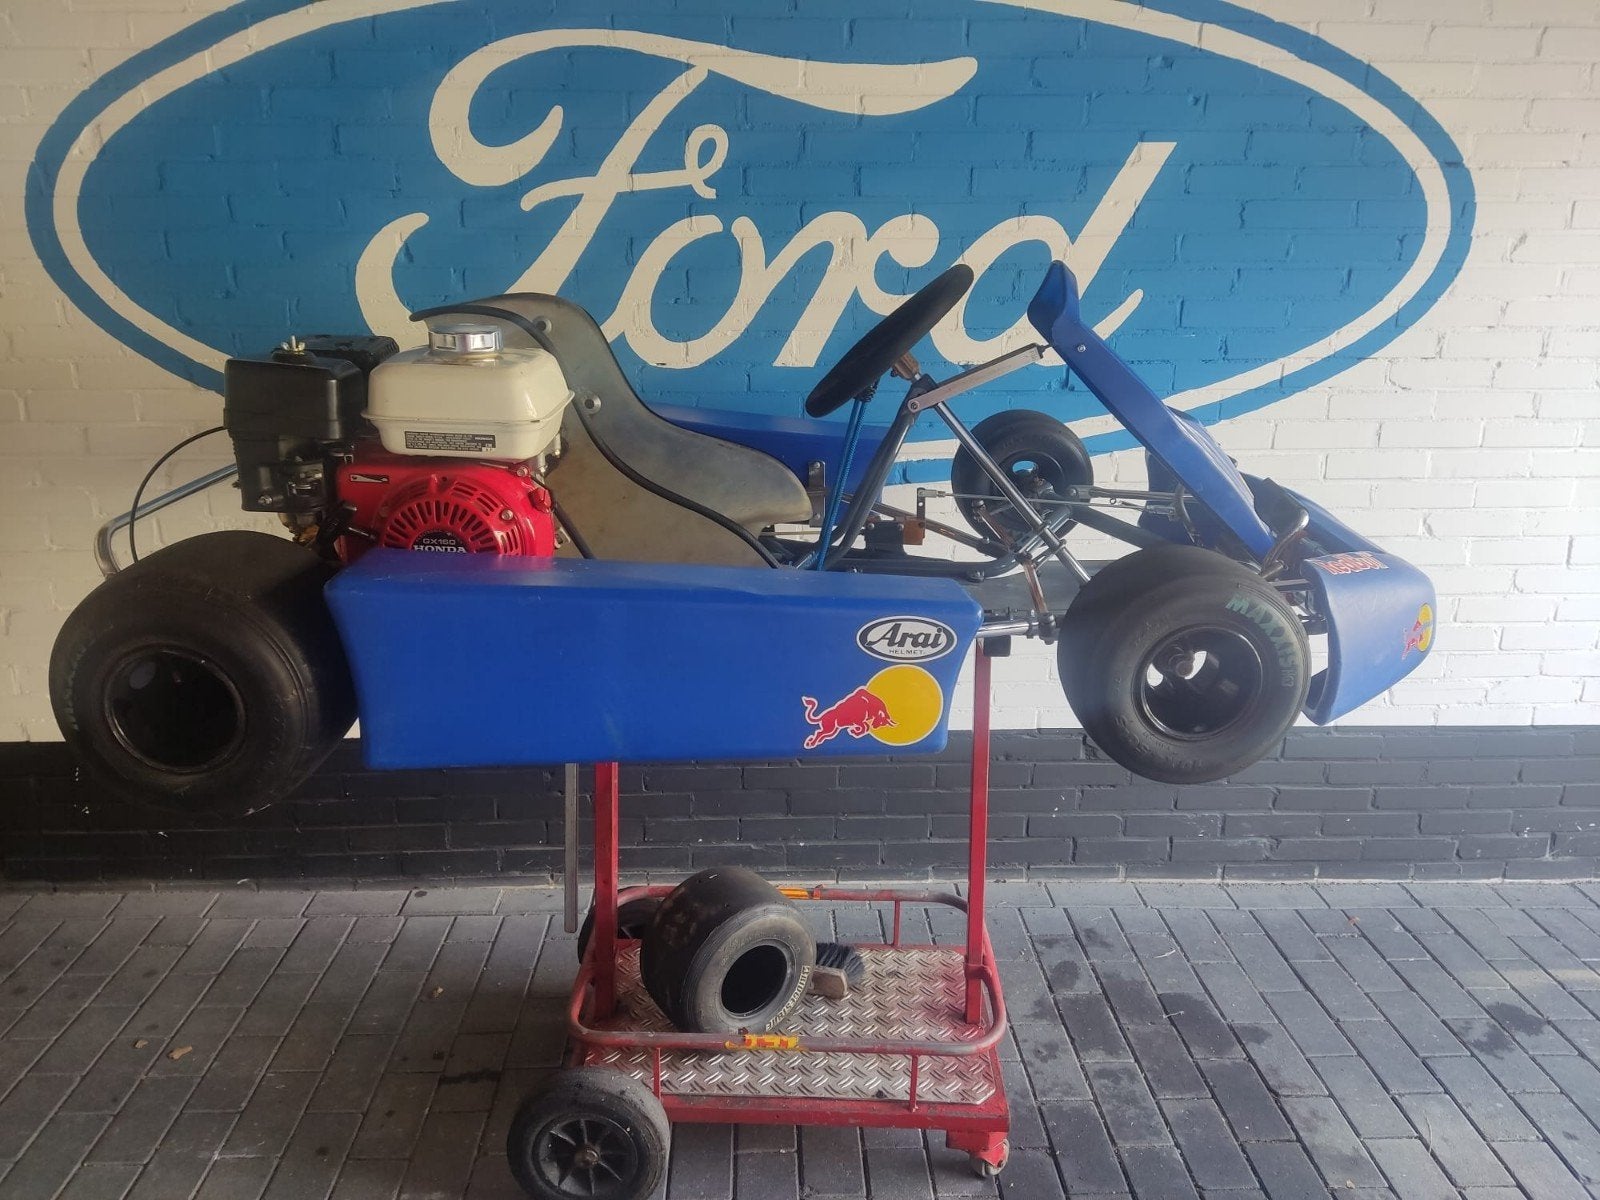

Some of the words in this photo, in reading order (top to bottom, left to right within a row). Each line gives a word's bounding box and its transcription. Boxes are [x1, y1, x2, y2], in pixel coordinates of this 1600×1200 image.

[355, 28, 1178, 368] Ford
[413, 545, 467, 553] HONDA
[865, 622, 943, 649] Arai
